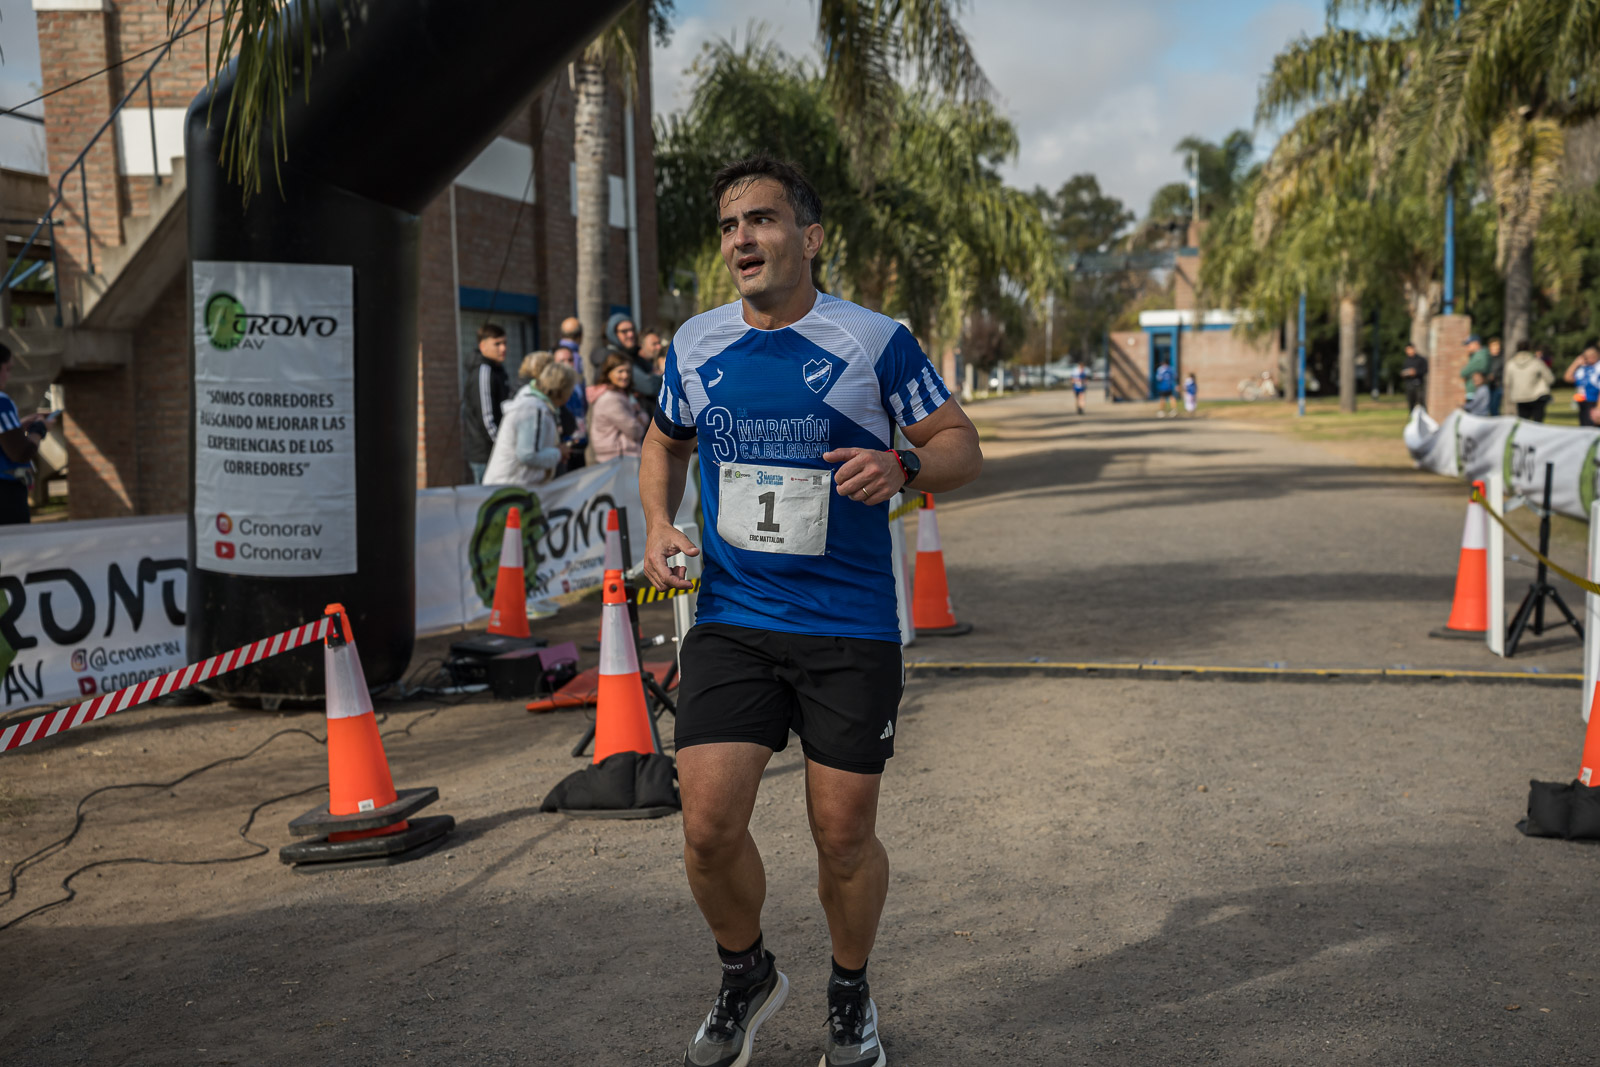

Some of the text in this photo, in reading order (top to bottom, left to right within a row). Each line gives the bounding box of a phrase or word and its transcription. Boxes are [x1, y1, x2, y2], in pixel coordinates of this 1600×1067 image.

[232, 314, 338, 337] CRONO
[247, 392, 334, 408] CORREDORES
[200, 411, 346, 431] BUSCANDO MEJORAR LAS
[737, 414, 830, 442] MARATÓN
[207, 435, 334, 454] EXPERIENCIAS DE LOS
[706, 406, 738, 463] 3
[757, 491, 780, 532] 1
[239, 518, 323, 537] Cronorav
[239, 542, 323, 561] Cronorav
[90, 640, 181, 672] @cronorav
